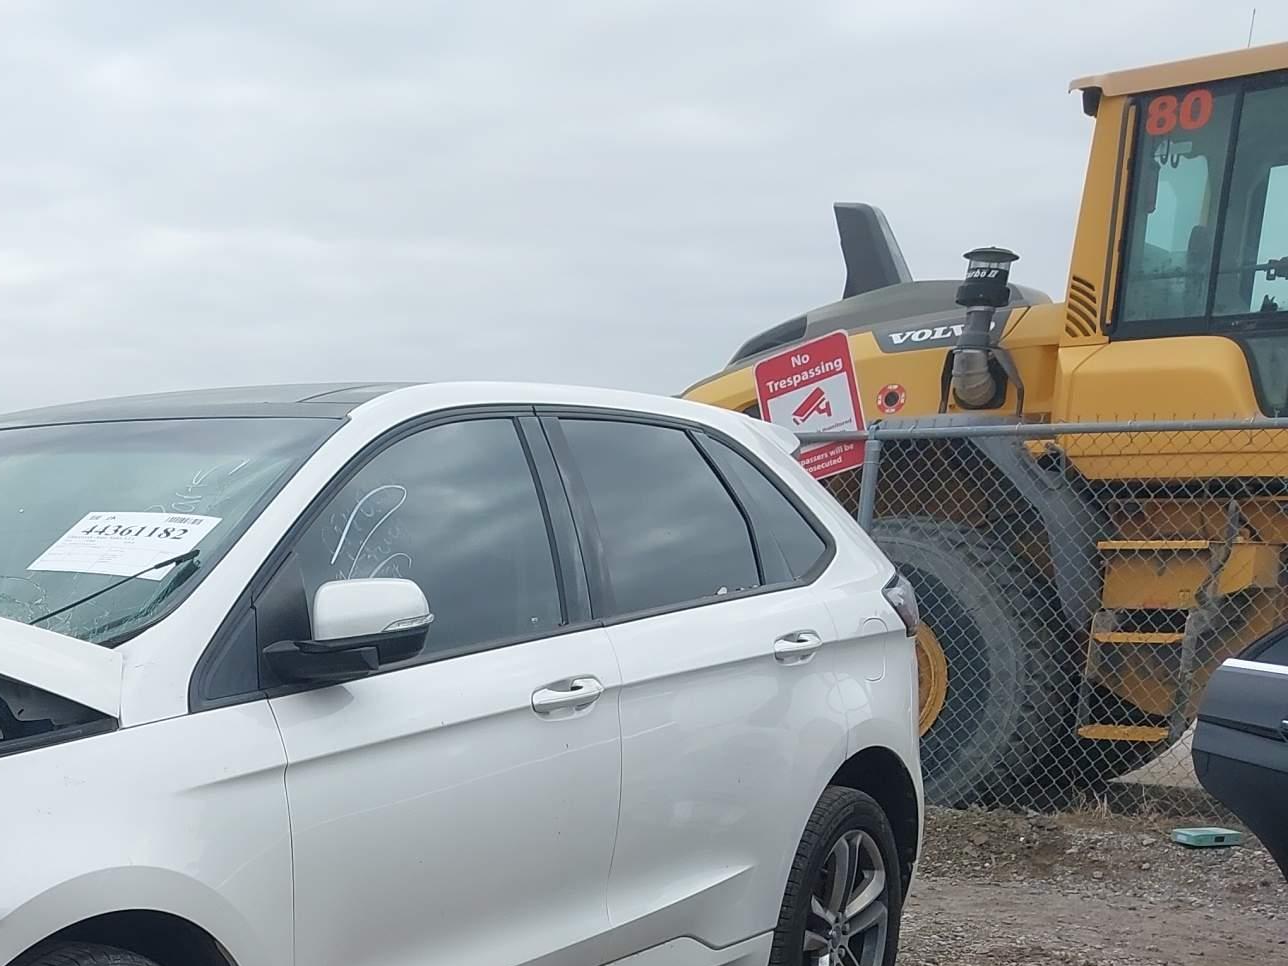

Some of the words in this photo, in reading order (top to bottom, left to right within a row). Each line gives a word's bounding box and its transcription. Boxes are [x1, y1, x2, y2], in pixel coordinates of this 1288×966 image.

[1145, 88, 1214, 137] 80
[888, 321, 996, 345] VOLV
[790, 354, 810, 368] No
[765, 358, 844, 393] Trespassing
[828, 446, 843, 457] will
[843, 443, 855, 452] be
[806, 456, 843, 472] rosecuted
[81, 524, 189, 541] 44361182
